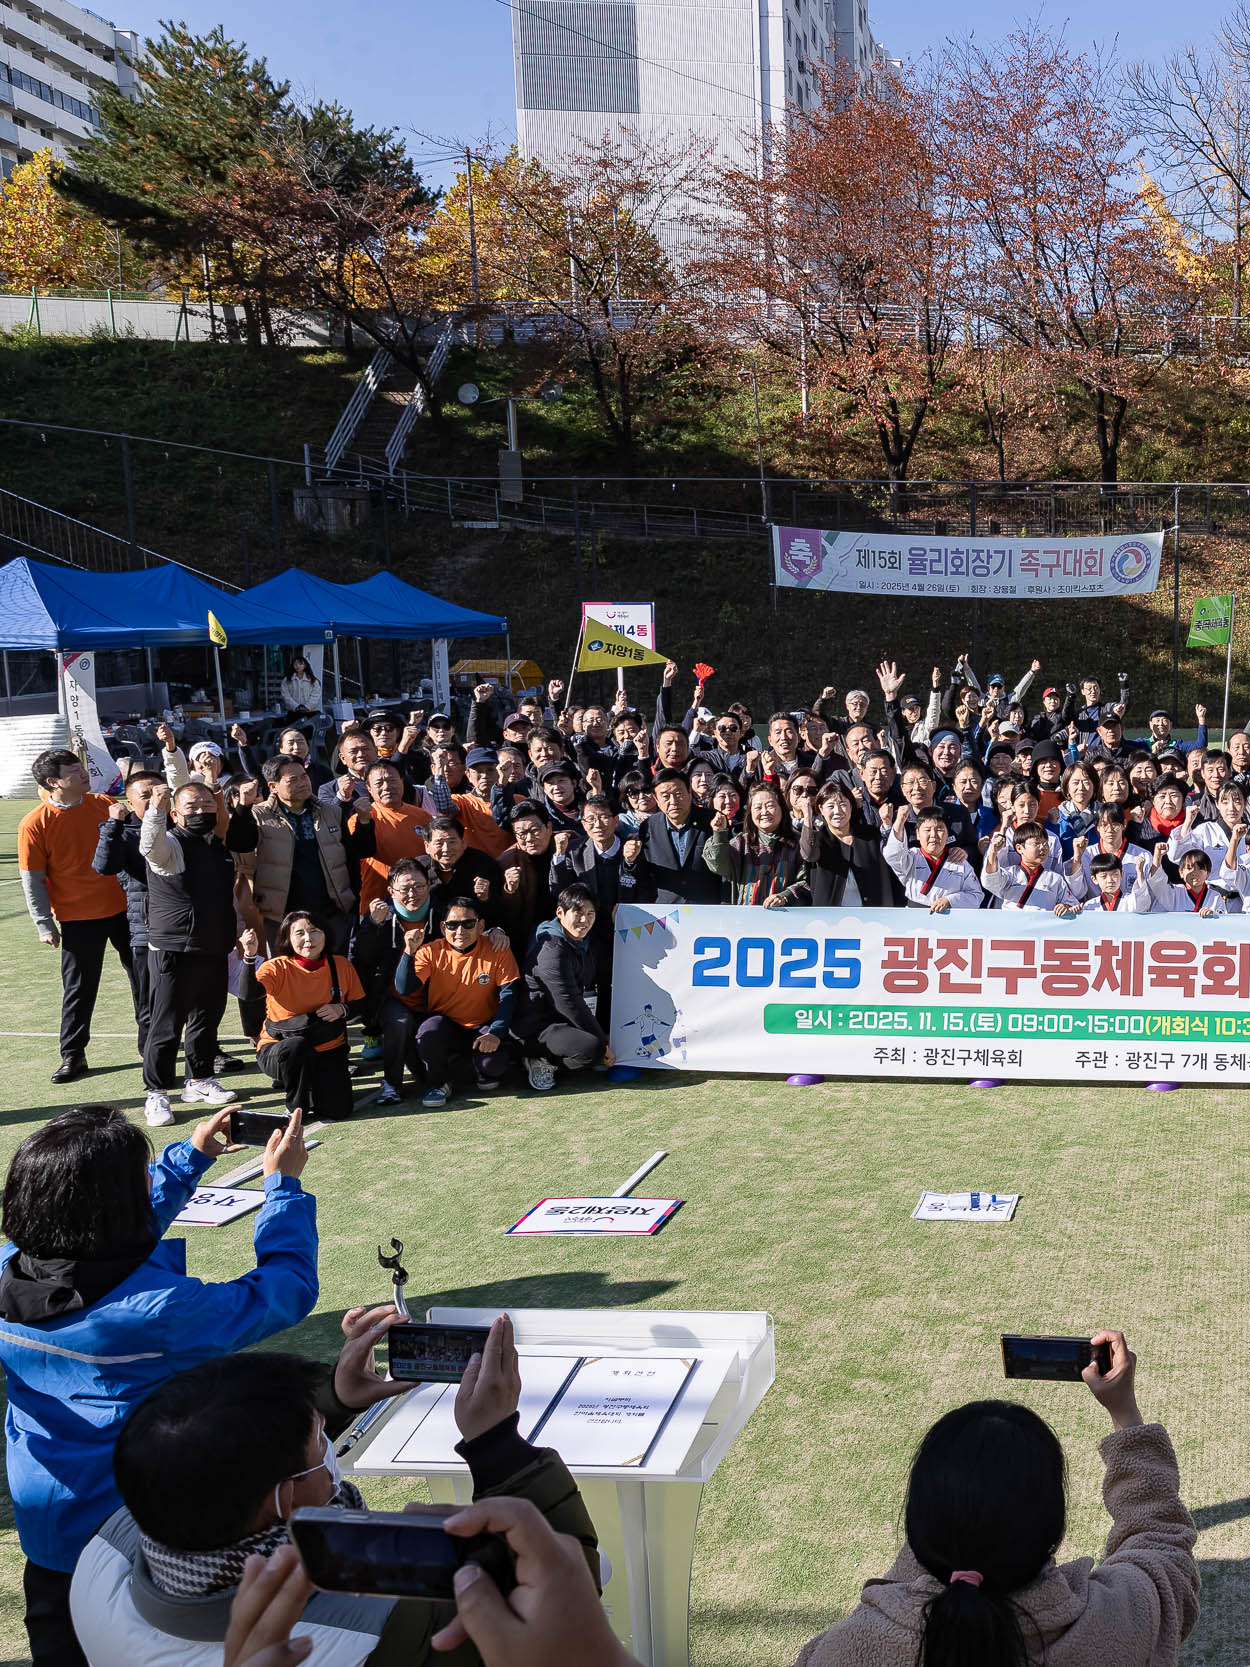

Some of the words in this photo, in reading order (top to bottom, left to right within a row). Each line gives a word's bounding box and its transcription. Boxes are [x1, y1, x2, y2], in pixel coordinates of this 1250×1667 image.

[788, 538, 813, 565] 축
[855, 548, 902, 571] 제15회
[907, 546, 1013, 578] 율리회장기
[1019, 548, 1104, 578] 족구대회
[858, 580, 875, 589] 일시
[881, 582, 910, 592] 2025년
[911, 583, 925, 592] 4월
[608, 624, 648, 637] 제4동
[603, 642, 646, 662] 자양1동
[691, 936, 862, 990] 2025
[881, 936, 1250, 999] 광진구동체육회
[794, 1009, 833, 1030] 일시
[848, 1010, 912, 1031] 2025.
[918, 1012, 936, 1032] 11.
[942, 1013, 1002, 1034] 15.(토)
[873, 1047, 906, 1066] 주최
[923, 1048, 1024, 1068] 광진구체육회
[1075, 1049, 1109, 1069] 주관
[1125, 1050, 1176, 1071] 광진구
[1181, 1052, 1208, 1072] 7개
[544, 1205, 656, 1216] 자양제2동
